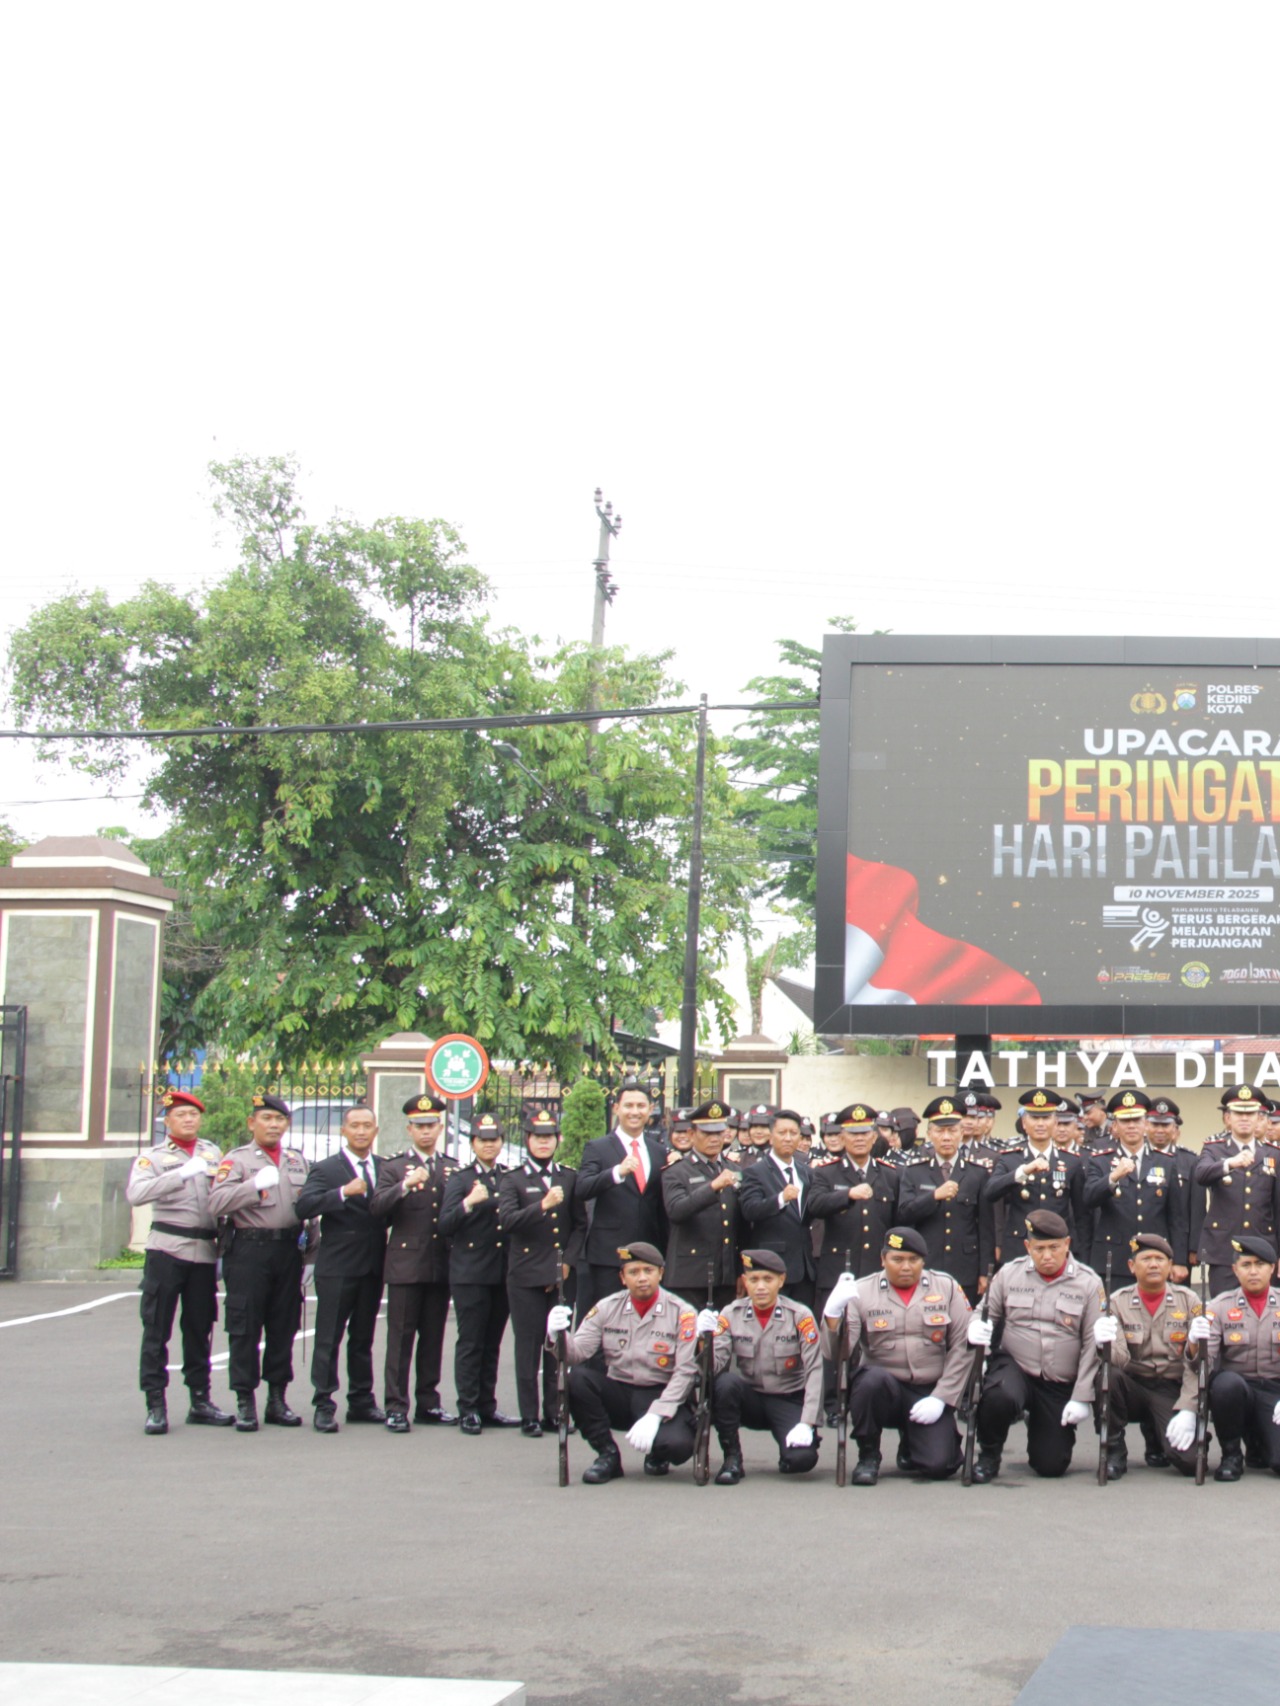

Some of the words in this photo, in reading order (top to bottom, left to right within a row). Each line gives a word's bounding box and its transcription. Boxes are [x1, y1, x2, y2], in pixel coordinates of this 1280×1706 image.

[1207, 685, 1260, 694] POLRES
[1207, 695, 1252, 704] KEDIRI
[1207, 704, 1244, 714] KOTA
[993, 824, 1107, 878] HARI
[1128, 889, 1142, 899] 10
[1145, 889, 1225, 899] NOVEMBER
[1227, 889, 1260, 899] 2025
[1171, 914, 1213, 924] TERUS
[1171, 927, 1271, 936] MELANJUTKAN
[1171, 938, 1262, 948] PERJUANGAN
[927, 1051, 1147, 1087] TATHYA
[1059, 1292, 1084, 1300] POLRI
[924, 1304, 947, 1312] POLRI
